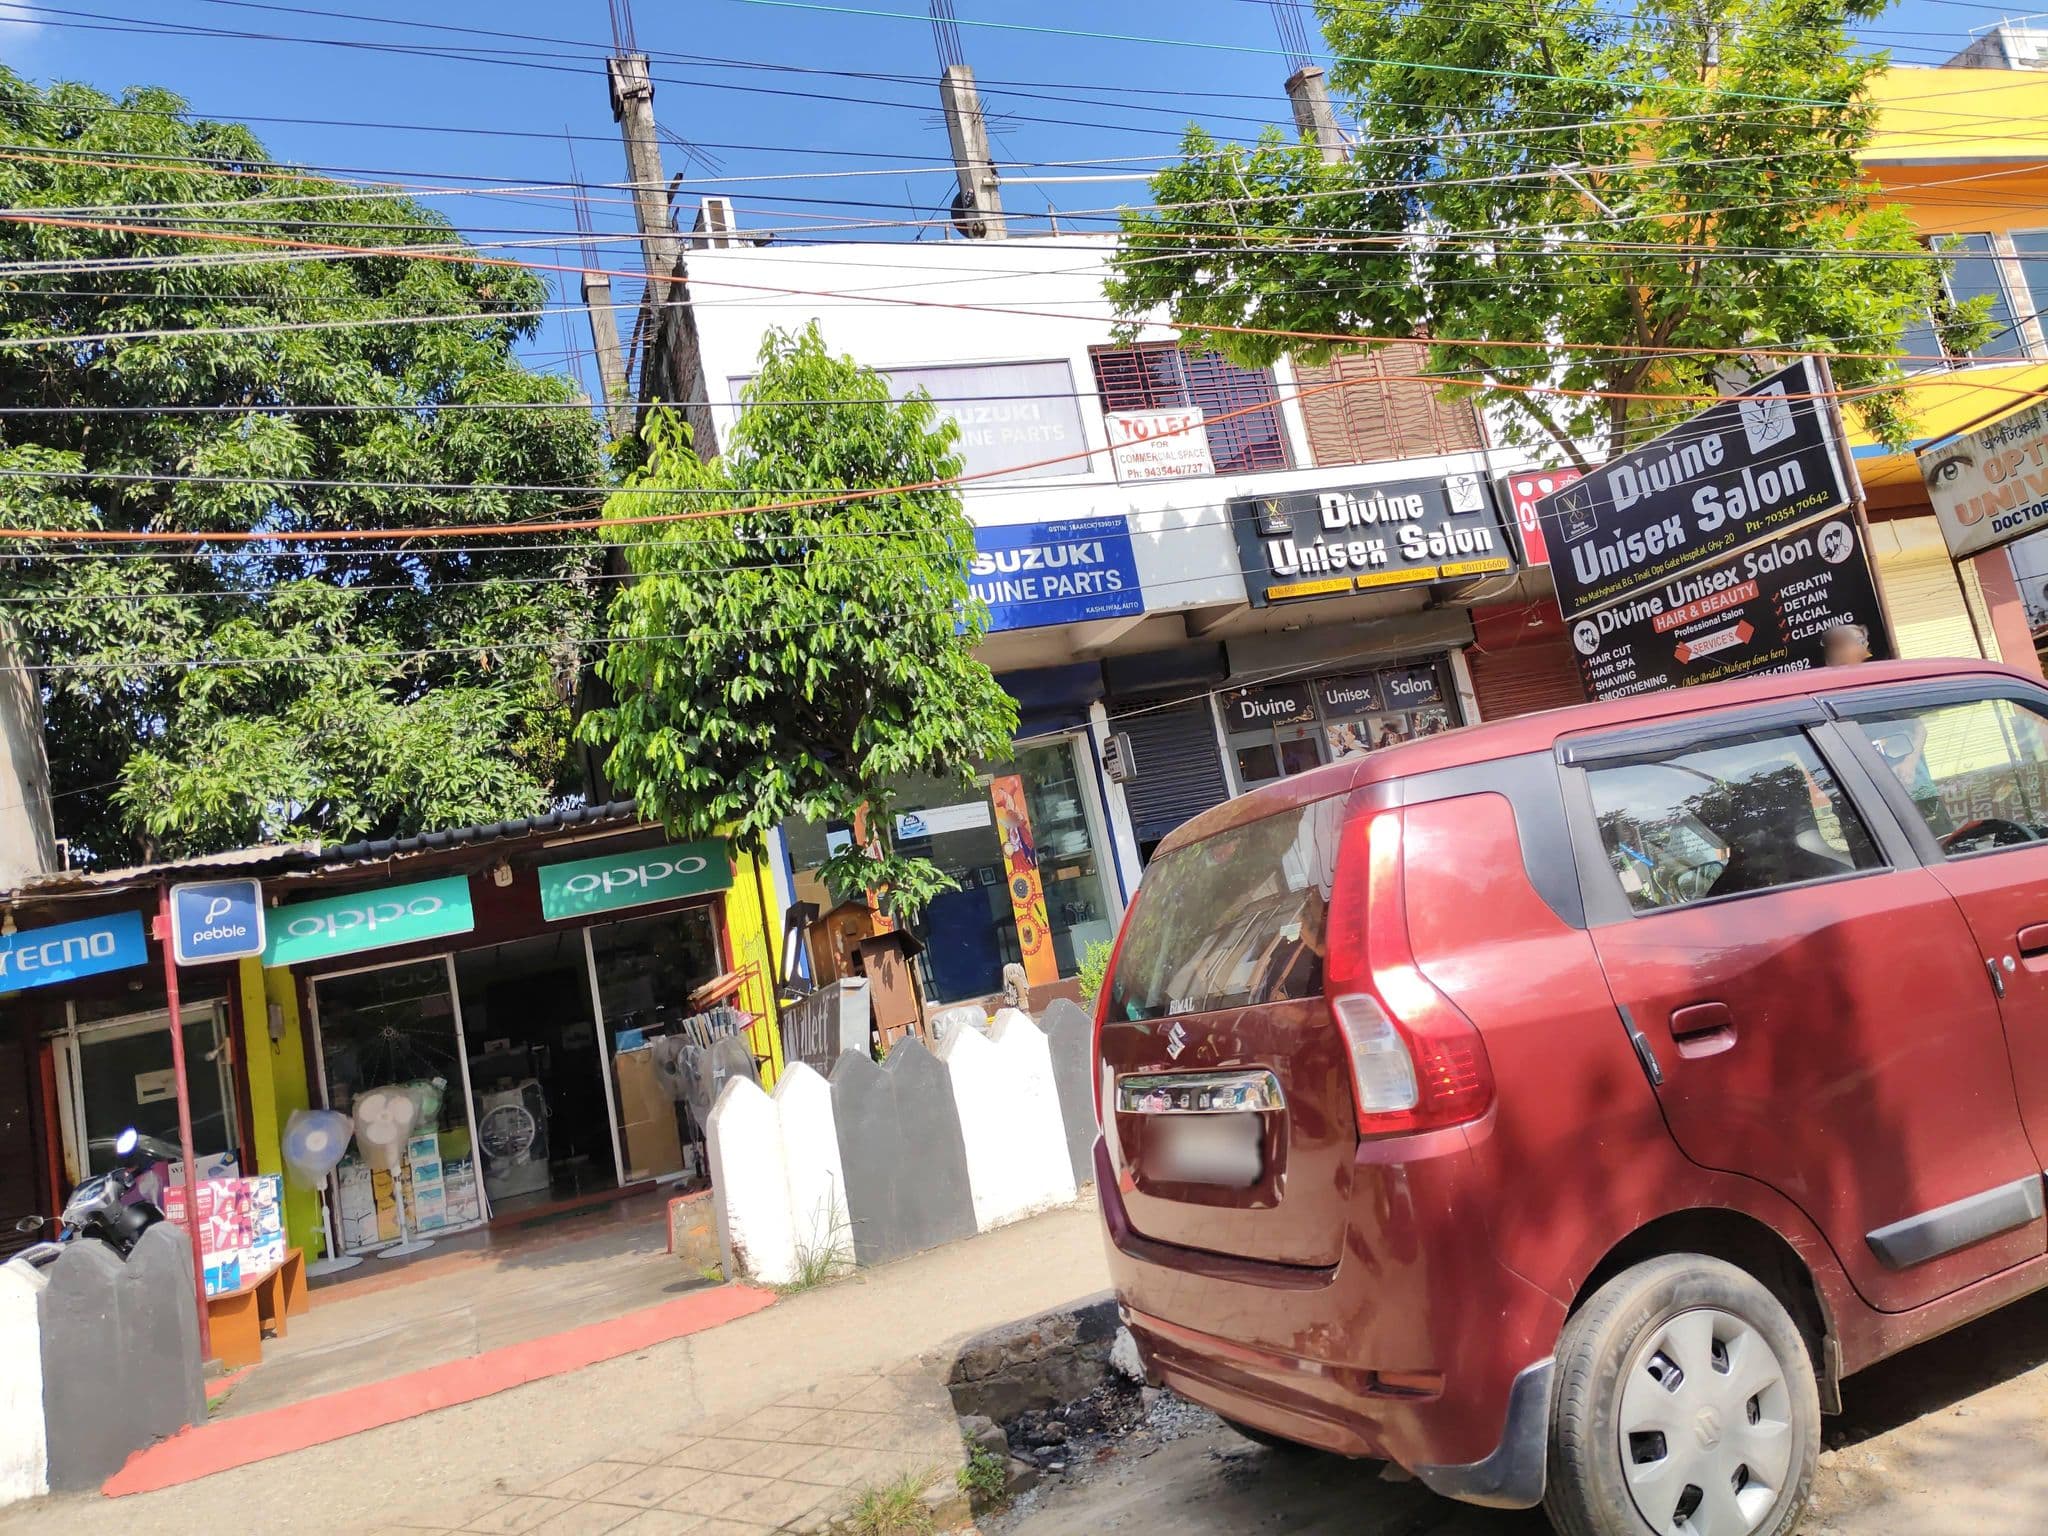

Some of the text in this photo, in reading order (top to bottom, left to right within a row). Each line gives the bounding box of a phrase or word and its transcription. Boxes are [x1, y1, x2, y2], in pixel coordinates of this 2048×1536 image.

[1001, 424, 1065, 445] PARTS
[1119, 416, 1191, 440] TO LET
[1120, 448, 1205, 464] COMMERCIAL SPACE
[1151, 440, 1169, 449] FOR
[1144, 463, 1204, 477] 94354-07737
[1607, 433, 1724, 512] Divine
[1319, 490, 1424, 529] Divine
[1570, 459, 1806, 585] Unisex Salon
[1765, 505, 1796, 526] 70354
[1796, 490, 1829, 513] 70642
[971, 542, 1105, 576] SUZUKI
[1268, 522, 1493, 576] Unisex Salon
[1651, 563, 1665, 575] Opp
[1664, 557, 1681, 569] Gate
[1725, 533, 1735, 545] 20
[1044, 570, 1122, 597] PARTS
[1597, 537, 1812, 635] Divine Unisex Salon
[1780, 571, 1833, 599] KERATIN
[1122, 601, 1139, 609] AUTO
[1656, 584, 1755, 631] HAIR & BEAUTY
[1784, 589, 1828, 612] DETAIN
[1674, 608, 1744, 639] Professional Salon
[1787, 604, 1831, 627] FACIAL
[1791, 612, 1854, 640] CLEANING
[1589, 644, 1632, 667] HAIR CUT
[1693, 631, 1735, 654] SERVICE'S
[1592, 658, 1636, 679] HAIR SPA
[1700, 666, 1721, 681] Bridal
[1723, 660, 1752, 676] Makeup
[1752, 654, 1768, 668] done
[1770, 646, 1788, 660] here)
[1595, 670, 1637, 691] SHAVING
[1598, 674, 1668, 702] SMOOTHENING
[1241, 677, 1432, 719] Divine Unisex Salon
[566, 856, 707, 894] oppo
[288, 897, 443, 938] oppo
[193, 924, 246, 945] pebble
